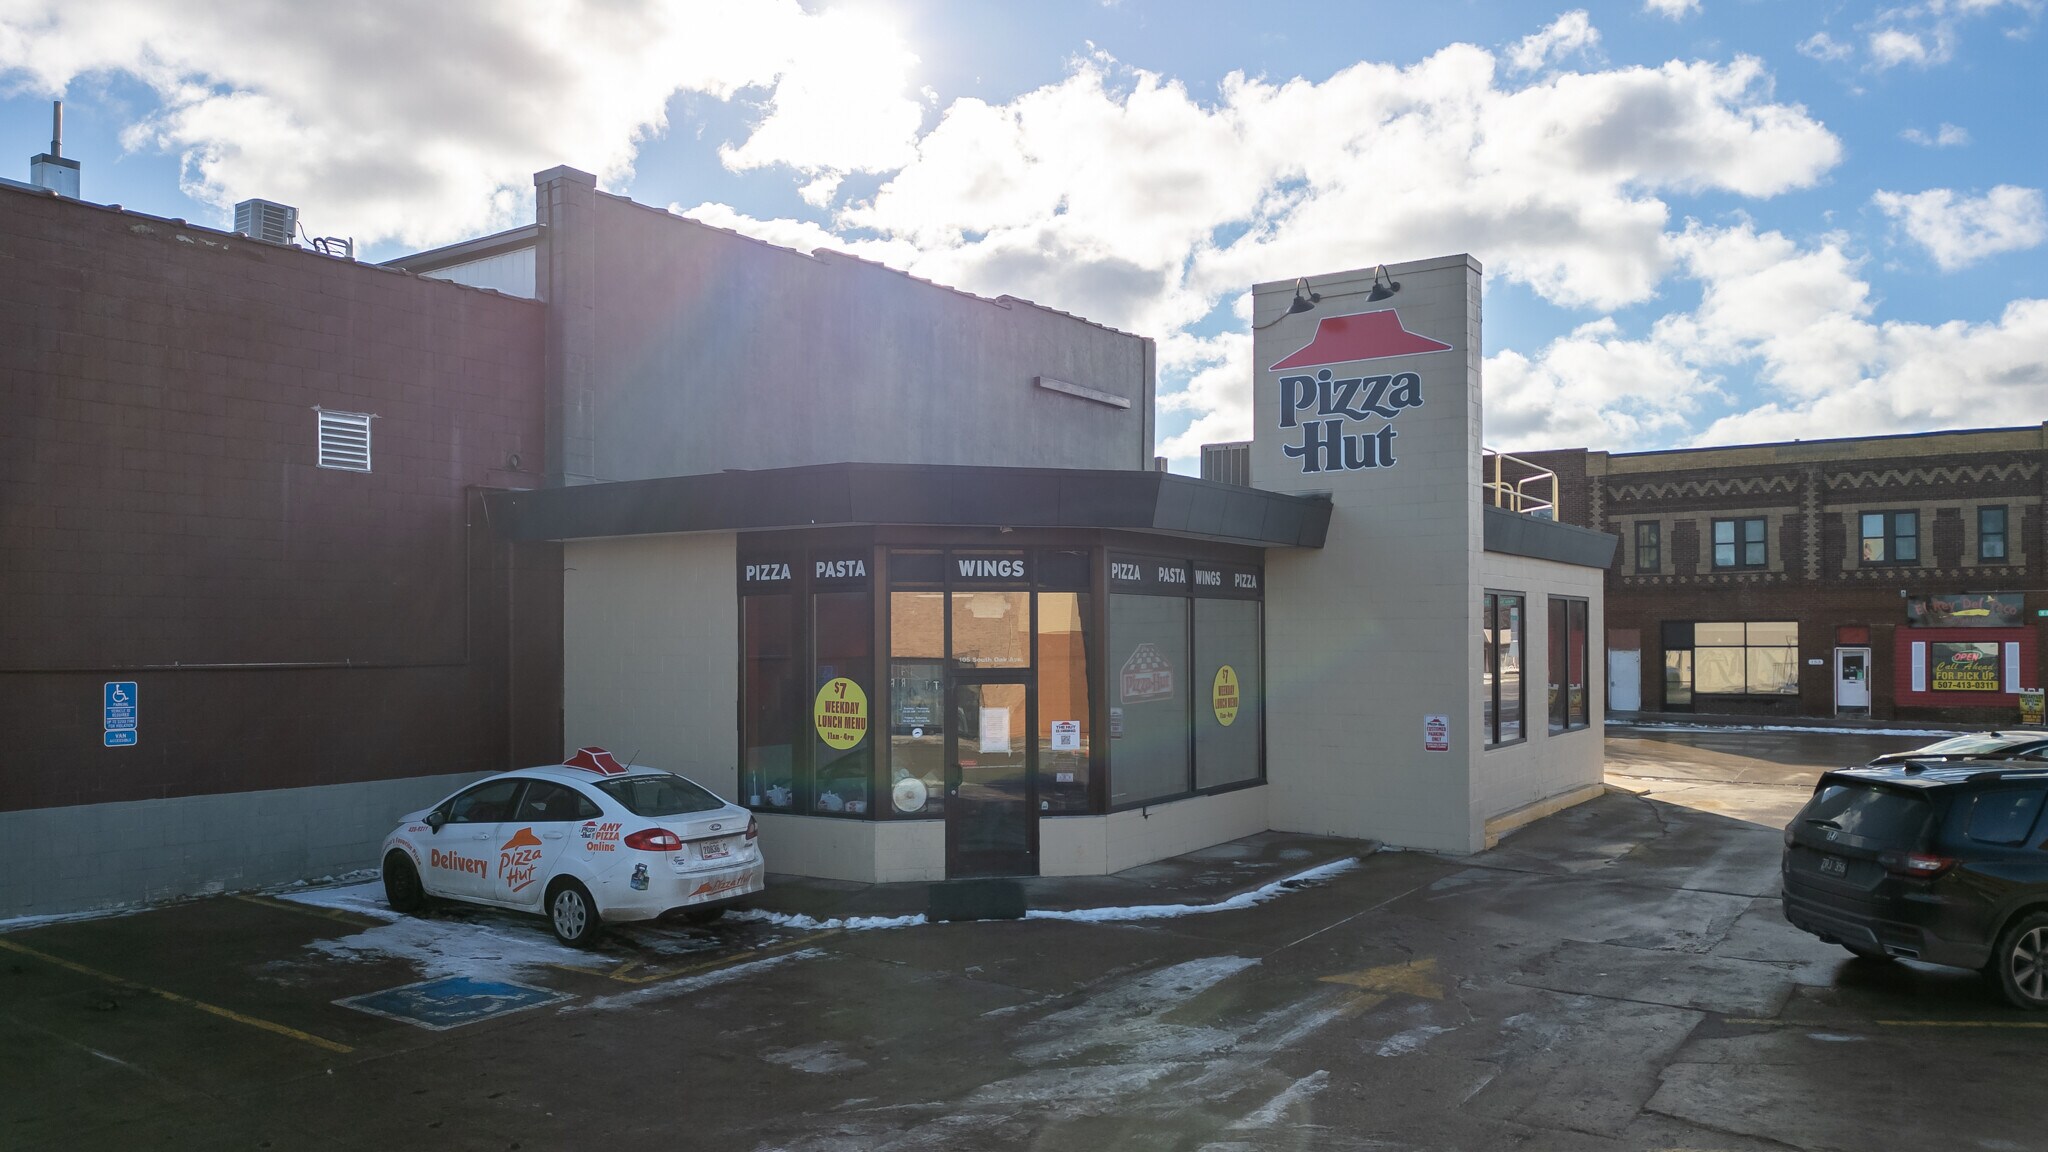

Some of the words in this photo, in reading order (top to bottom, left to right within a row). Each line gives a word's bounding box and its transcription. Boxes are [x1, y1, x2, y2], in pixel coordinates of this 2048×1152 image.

[1278, 369, 1424, 428] Pizza
[1283, 419, 1398, 473] Hut
[745, 564, 792, 581] PIZZA
[815, 560, 866, 578] PASTA
[958, 560, 1025, 577] WINGS
[1111, 563, 1141, 580] PIZZA
[1158, 567, 1186, 583] PASTA
[1195, 570, 1221, 586] WINGS
[1234, 574, 1257, 588] PIZZA
[1962, 597, 1984, 609] Del
[1954, 652, 1979, 661] OPEN
[1936, 662, 1959, 671] Call
[1936, 671, 1955, 680] FOR
[1957, 671, 1980, 680] PICK
[1982, 671, 1995, 680] UP
[834, 681, 847, 699] $7
[825, 700, 860, 715] WEEKDAY
[817, 715, 843, 728] LUNCH
[844, 716, 866, 730] MENU
[599, 823, 622, 832] ANY
[595, 832, 620, 841] PIZZA
[586, 841, 615, 852] Online
[431, 848, 487, 879] Delivery
[499, 846, 542, 879] Pizza
[506, 864, 537, 888] Hut
[712, 879, 737, 891] Pizza
